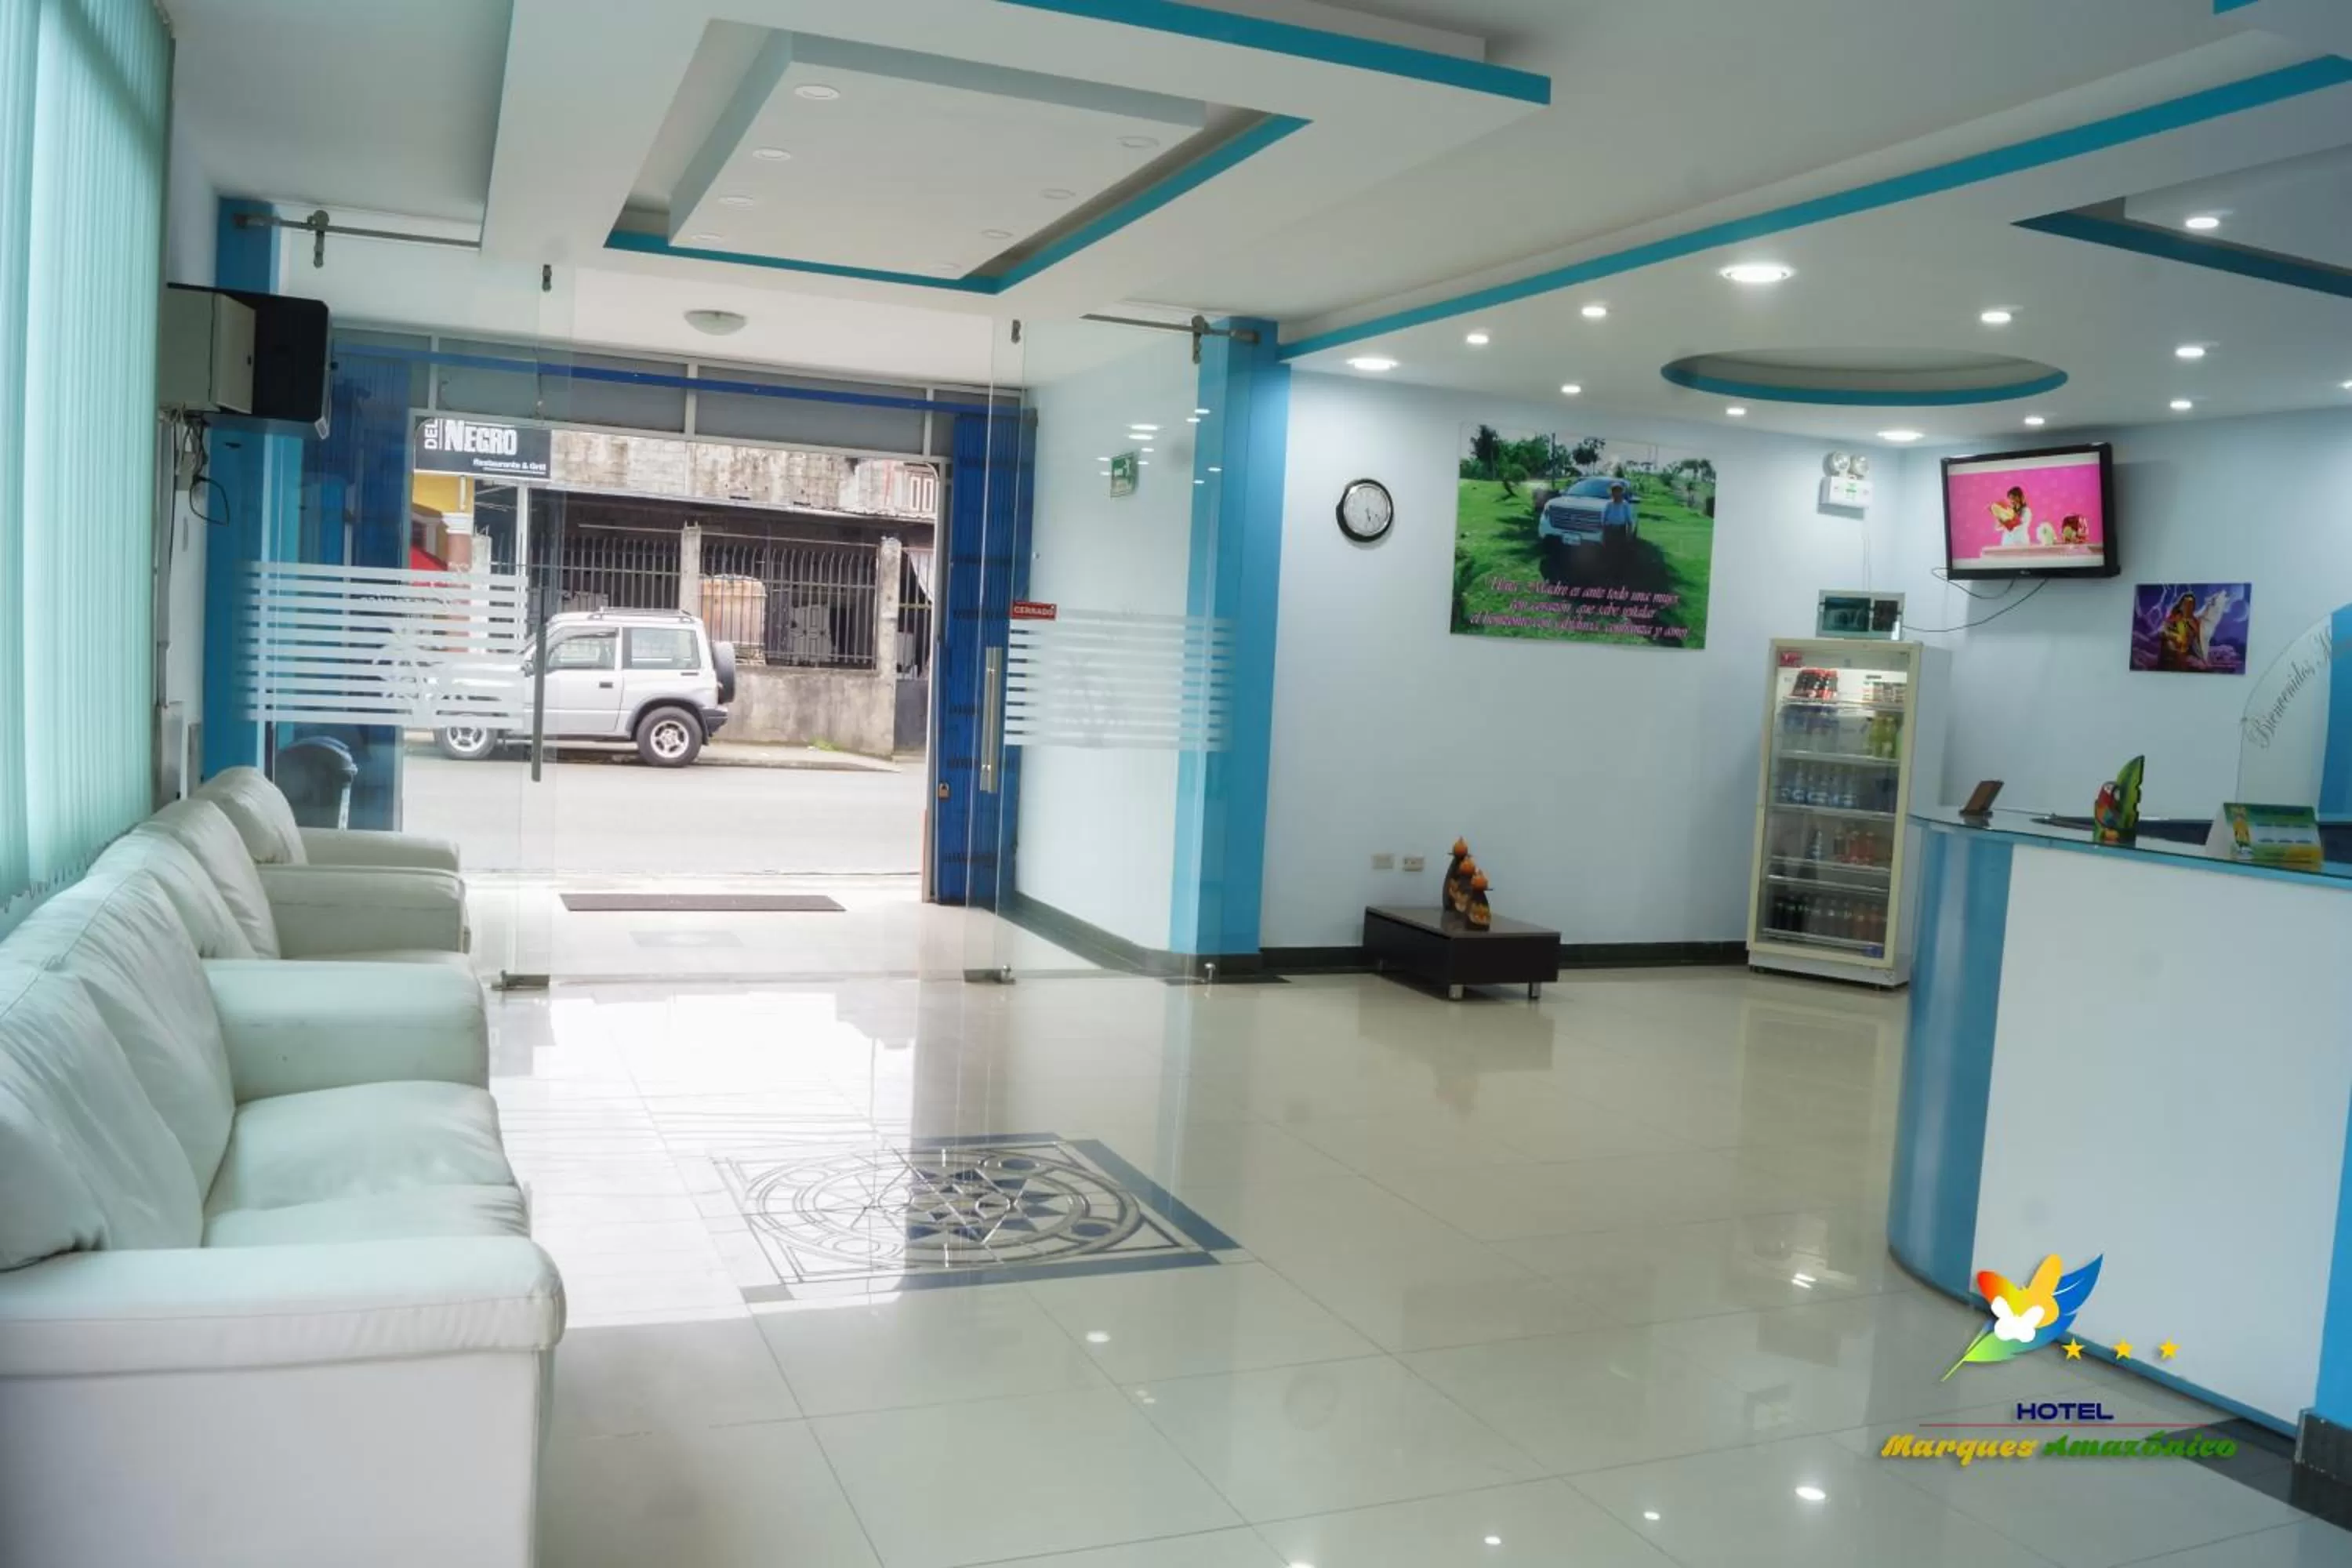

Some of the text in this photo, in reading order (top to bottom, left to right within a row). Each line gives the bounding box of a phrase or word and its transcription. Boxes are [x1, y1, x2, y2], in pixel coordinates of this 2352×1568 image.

[424, 418, 438, 450] DEL
[445, 419, 518, 456] NEGRO
[1014, 605, 1054, 615] CERRADO
